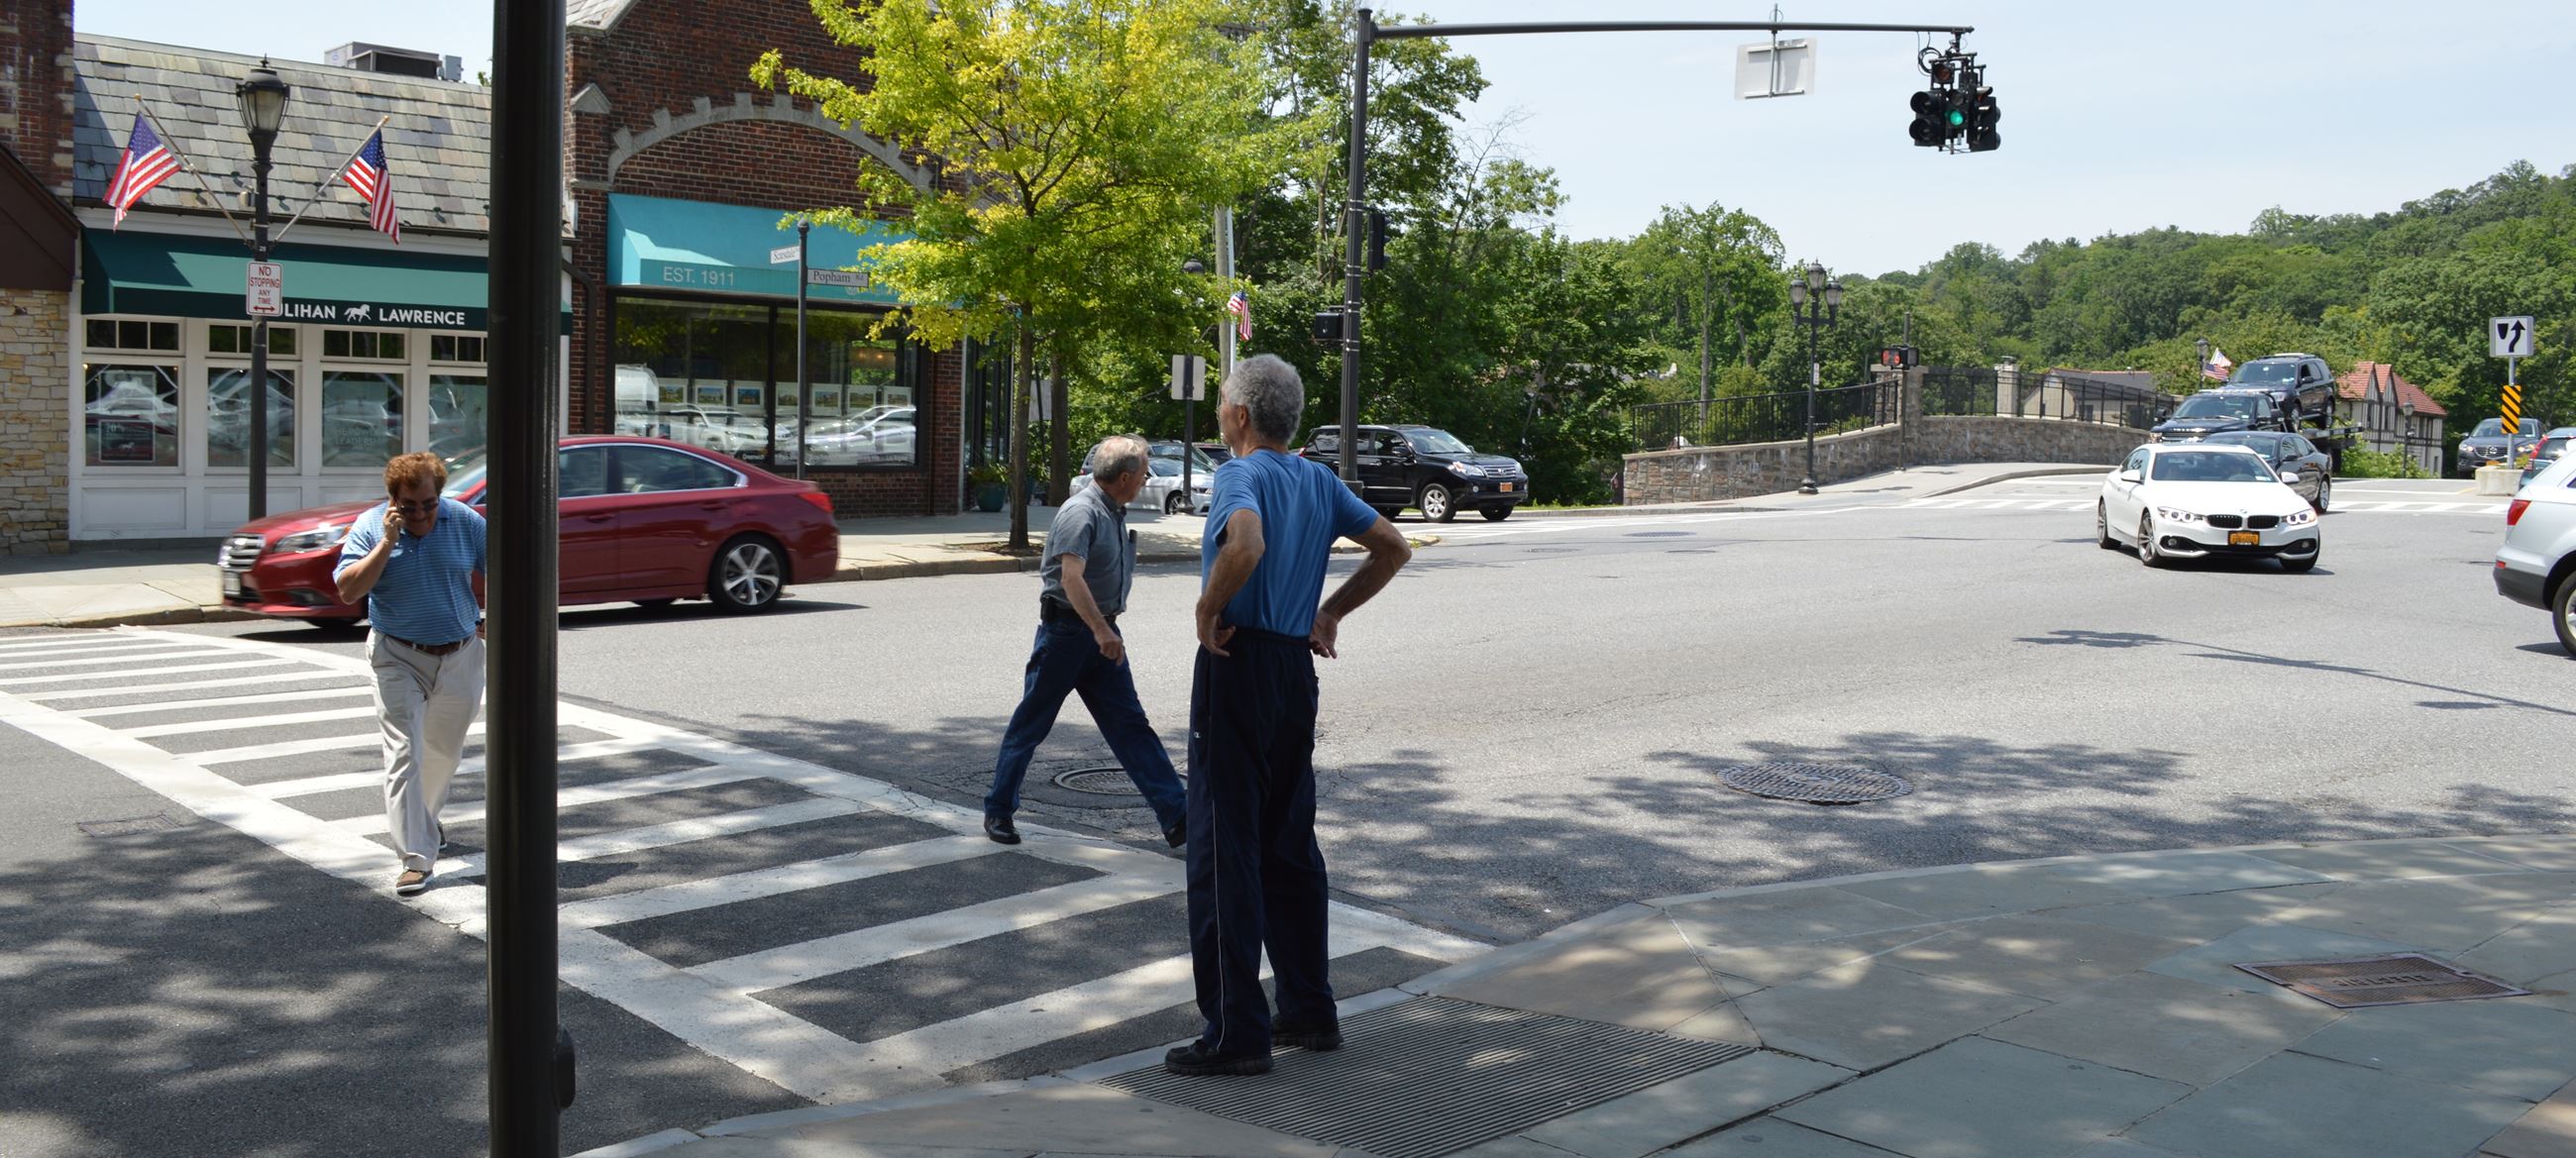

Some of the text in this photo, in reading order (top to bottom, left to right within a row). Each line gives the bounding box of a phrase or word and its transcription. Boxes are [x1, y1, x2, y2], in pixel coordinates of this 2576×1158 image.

[259, 266, 271, 276] NO
[663, 266, 735, 286] EST. 1911
[812, 270, 851, 284] Popham
[250, 277, 280, 288] STOPPING
[378, 308, 466, 326] LAWRENCE
[2331, 975, 2434, 988] ELECTRIC
